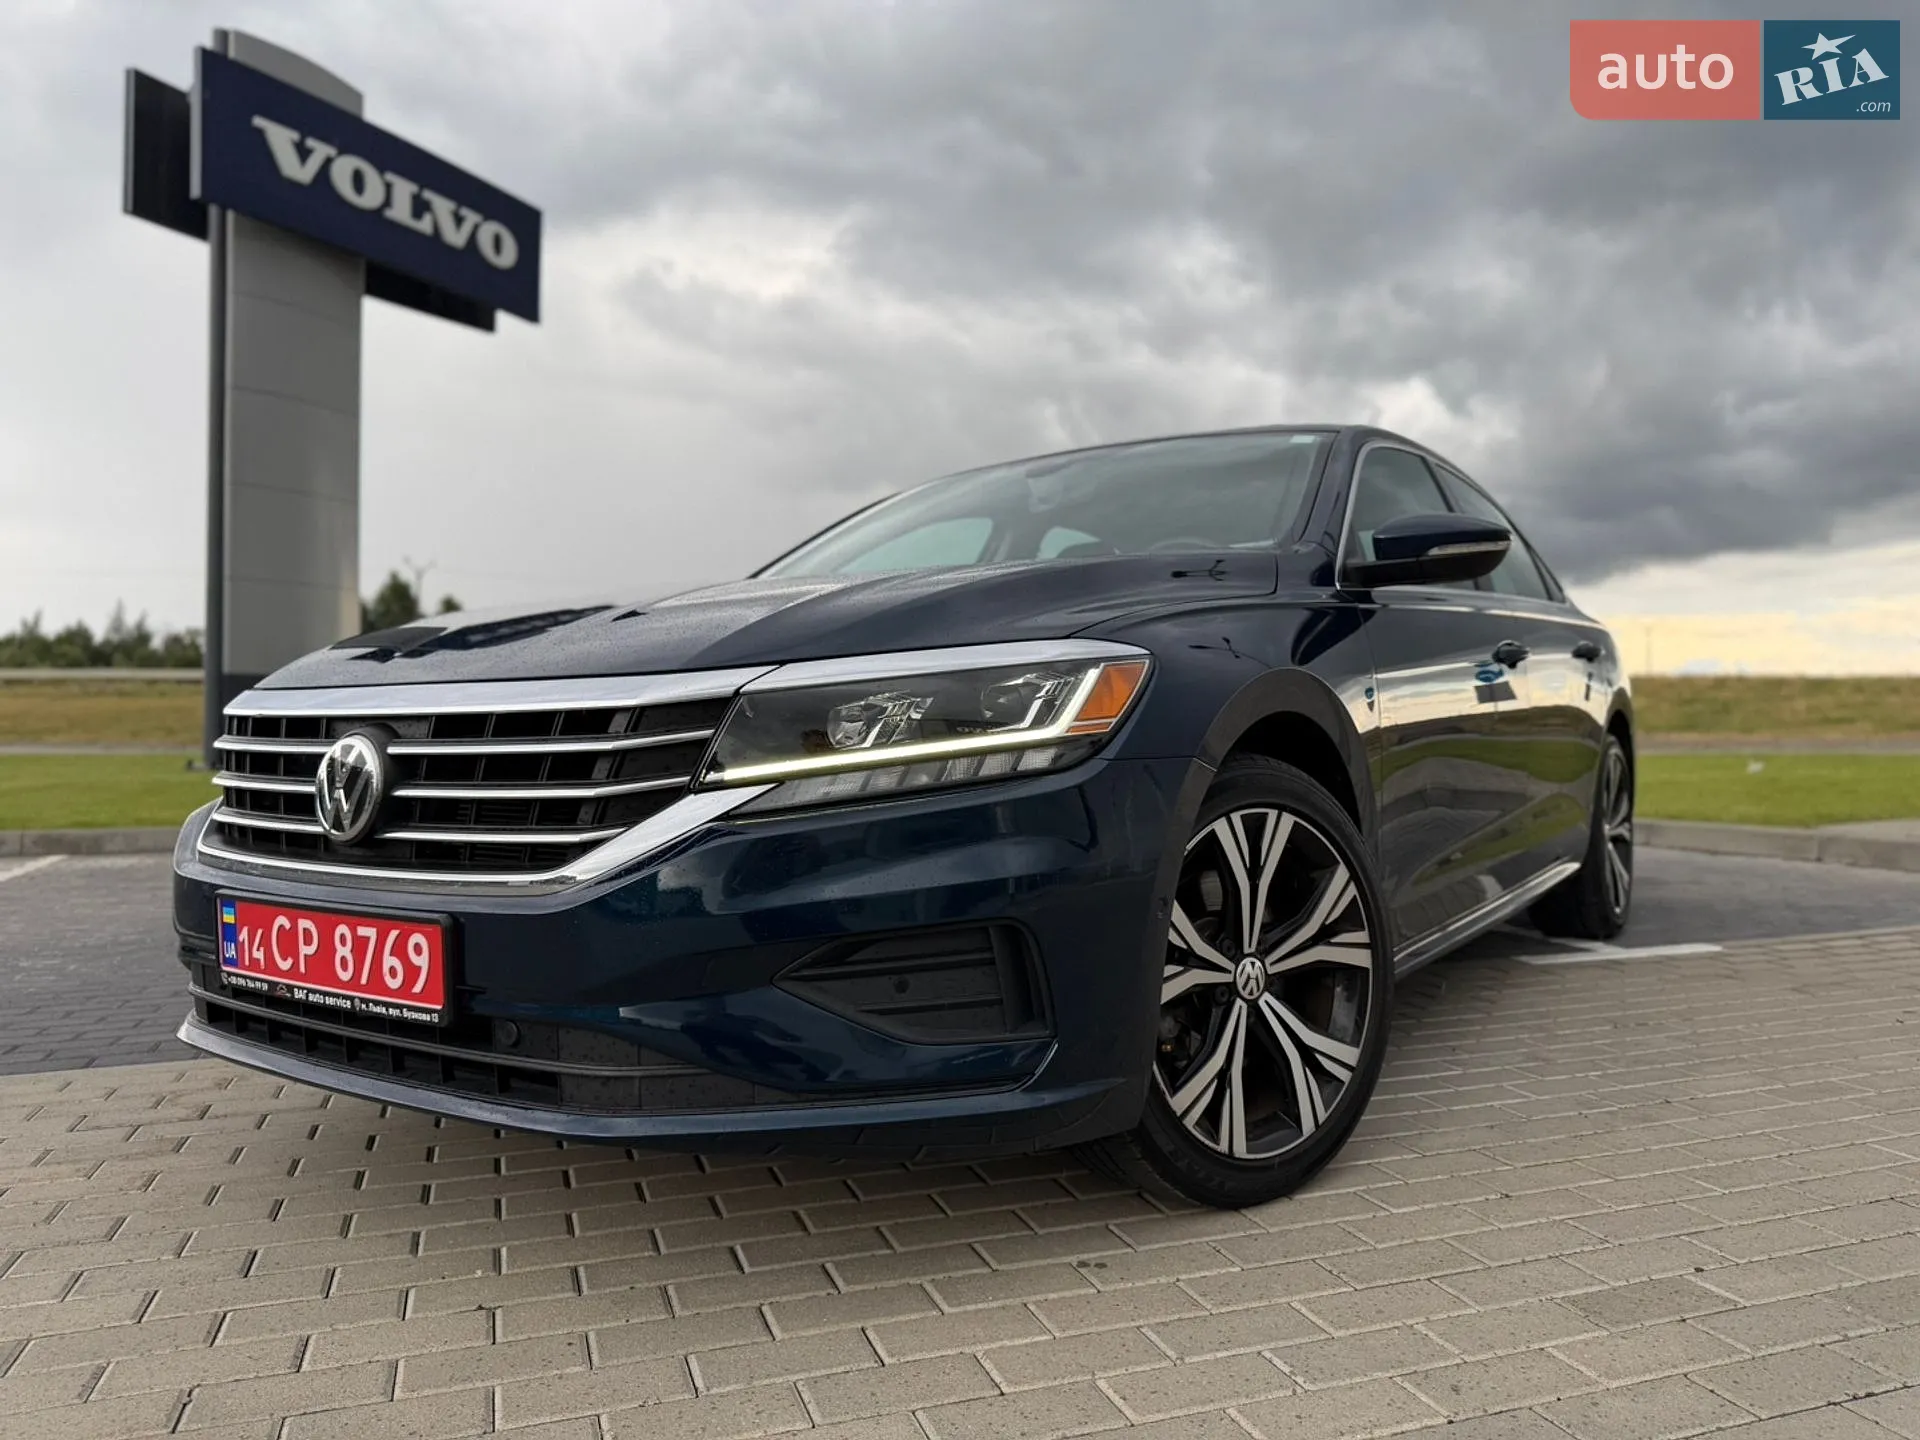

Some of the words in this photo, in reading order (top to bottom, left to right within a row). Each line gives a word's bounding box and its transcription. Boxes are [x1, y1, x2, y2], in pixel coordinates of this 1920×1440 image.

[251, 115, 520, 270] VOLVO
[224, 941, 236, 959] UA
[333, 923, 430, 994] 8769
[308, 993, 324, 1004] auto
[325, 996, 351, 1009] service
